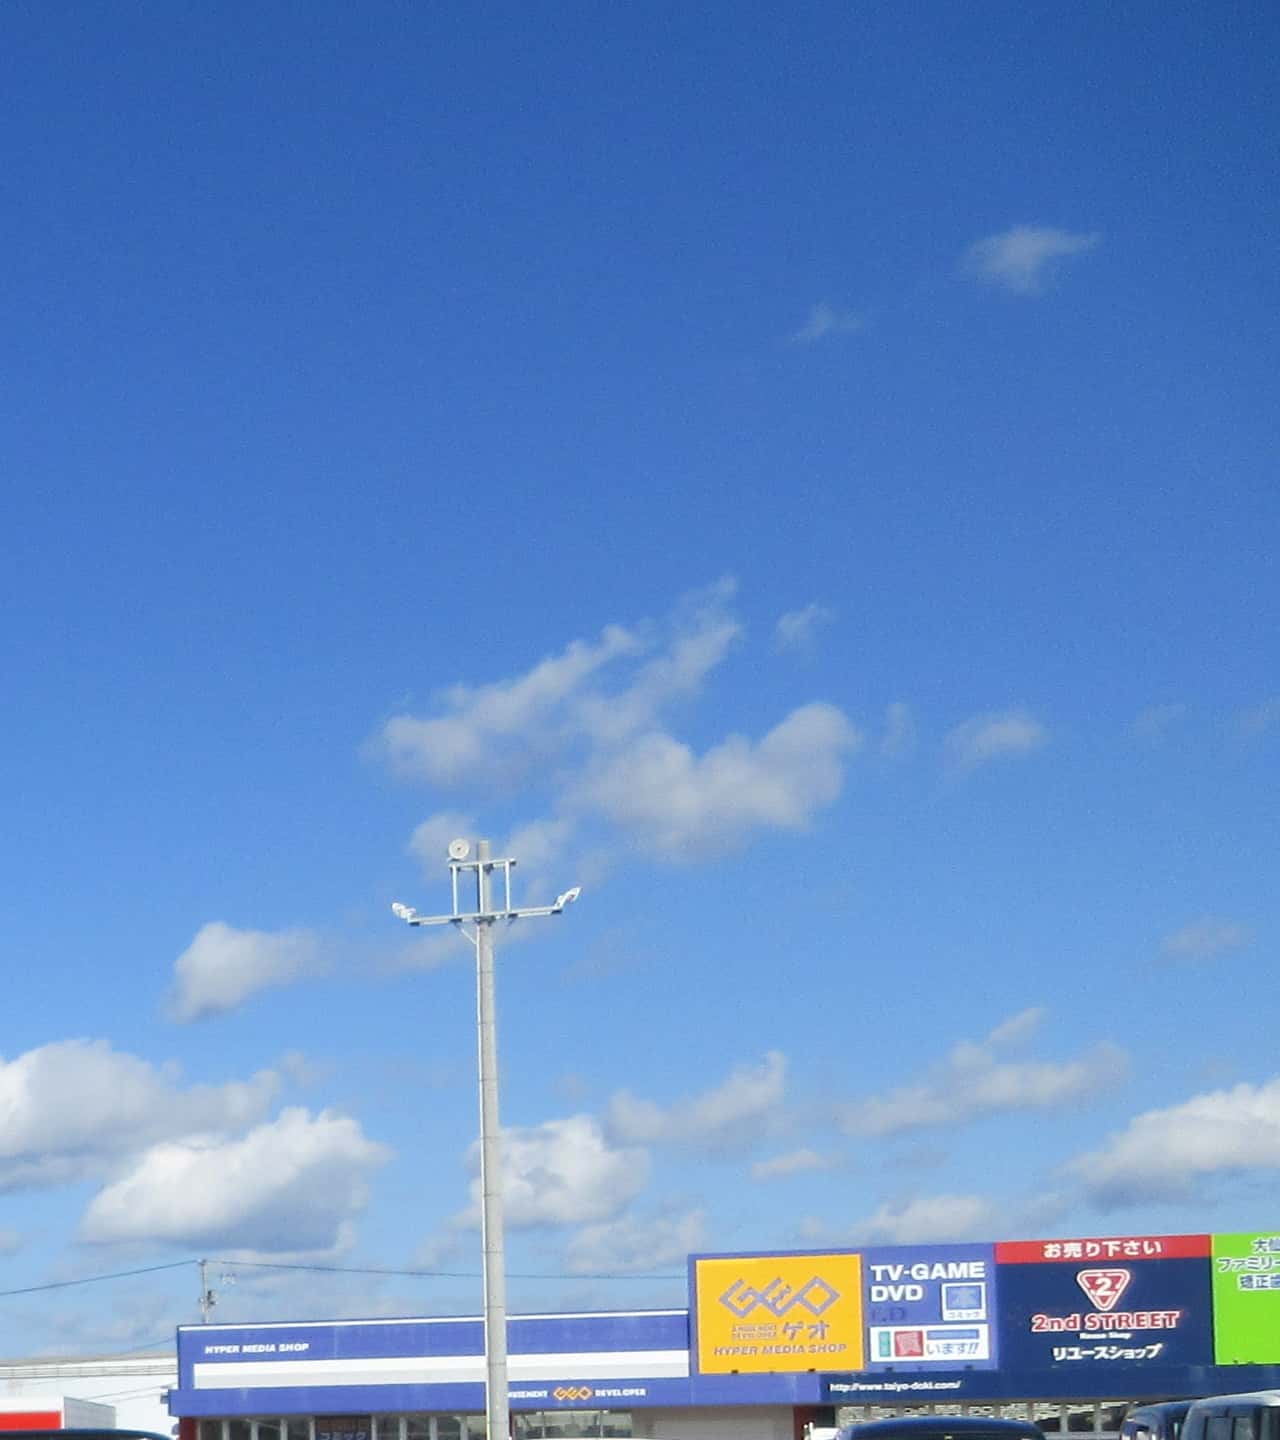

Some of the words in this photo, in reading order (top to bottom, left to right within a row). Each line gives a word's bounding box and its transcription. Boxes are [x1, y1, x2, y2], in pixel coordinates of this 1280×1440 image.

[1044, 1240, 1162, 1258] お売り下さい
[870, 1262, 986, 1282] TV-GAME
[719, 1276, 840, 1318] GEO
[871, 1284, 923, 1302] DVD
[782, 1320, 830, 1341] ゲオ
[1031, 1314, 1080, 1332] 2nd
[1084, 1311, 1180, 1331] STREET
[204, 1346, 239, 1354] HYPER
[242, 1344, 276, 1353] MEDIA
[278, 1343, 309, 1352] SHOP
[714, 1346, 757, 1356] HYPER
[762, 1345, 804, 1355] MEDIA
[808, 1343, 847, 1353] SHOP
